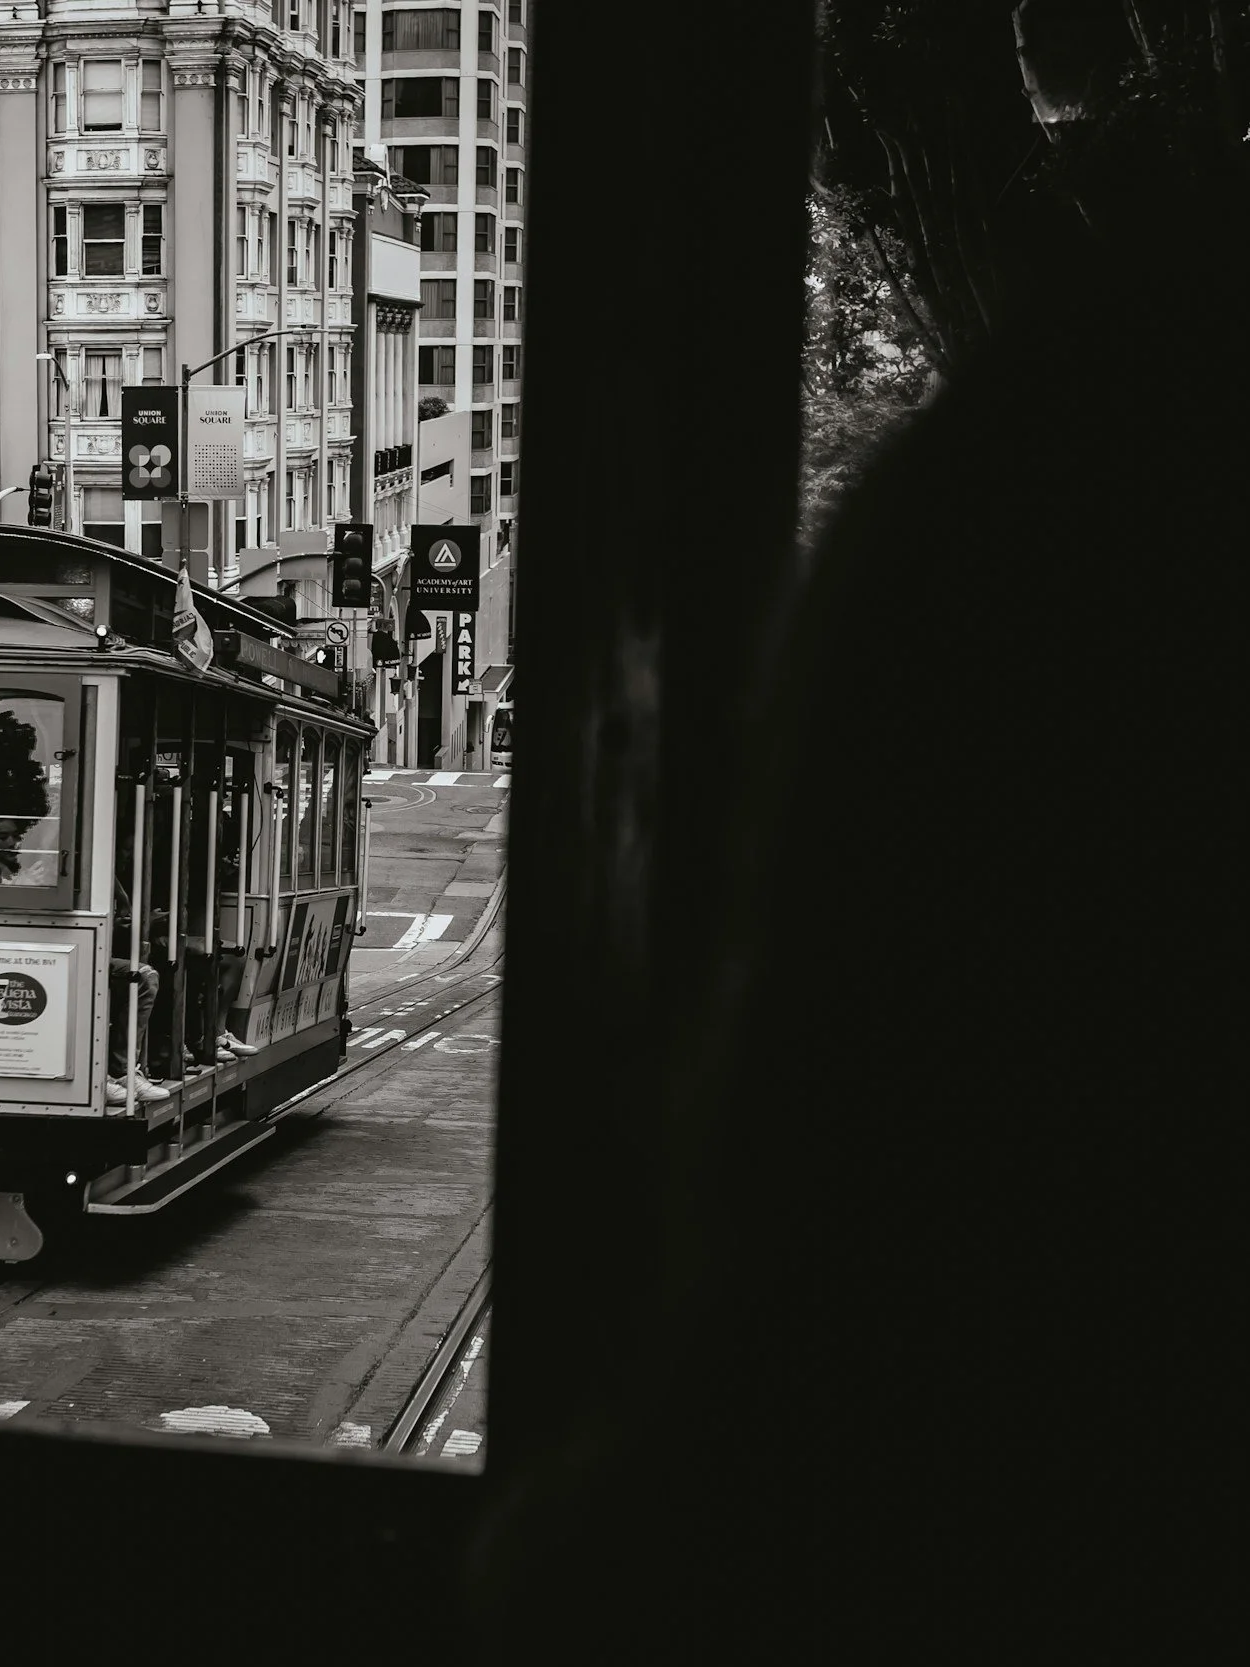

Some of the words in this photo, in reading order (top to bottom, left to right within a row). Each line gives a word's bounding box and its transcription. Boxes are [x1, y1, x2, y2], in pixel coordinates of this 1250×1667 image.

[133, 416, 167, 425] SQUARE
[199, 416, 232, 425] SQUARE
[416, 578, 452, 586] ACADEMY
[457, 613, 473, 676] PARK
